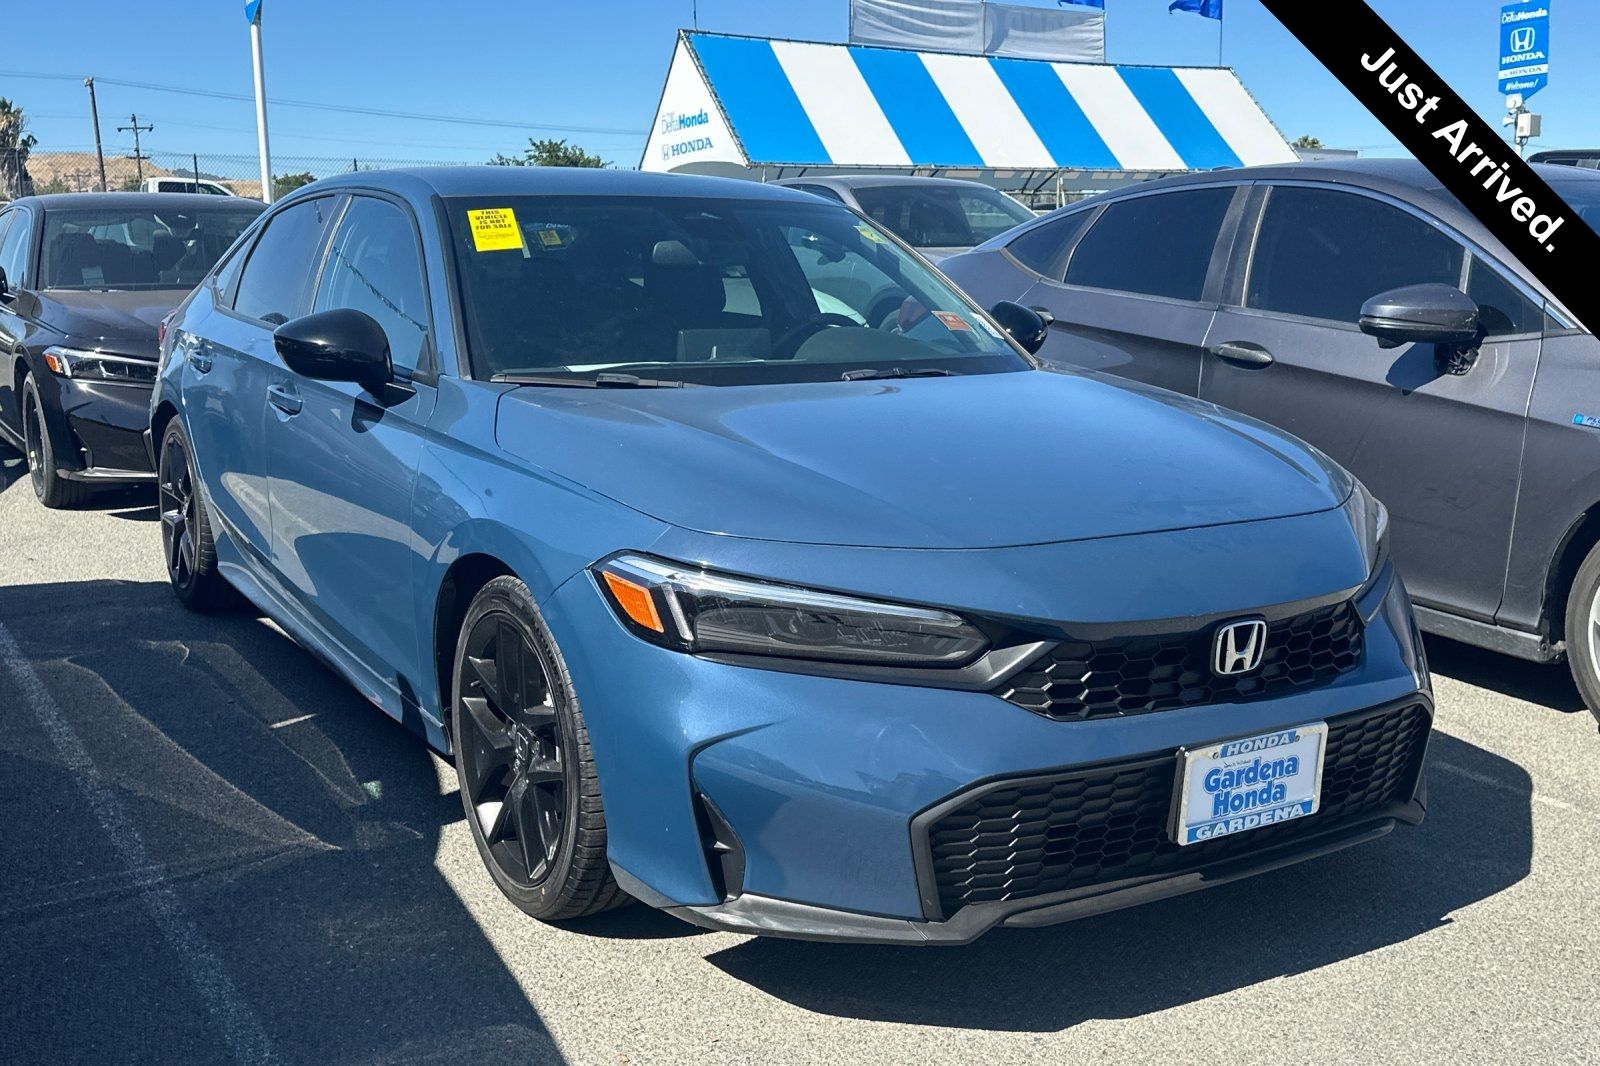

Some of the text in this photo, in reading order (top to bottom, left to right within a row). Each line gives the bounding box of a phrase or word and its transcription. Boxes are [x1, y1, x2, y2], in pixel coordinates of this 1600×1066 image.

[1501, 51, 1546, 65] HONDA
[1509, 66, 1543, 76] HONDA
[671, 137, 714, 157] HONDA
[1227, 733, 1291, 757] HONDA
[1203, 755, 1300, 794] Gardena
[1211, 780, 1287, 818] Honda
[1195, 804, 1305, 840] GARDENA
